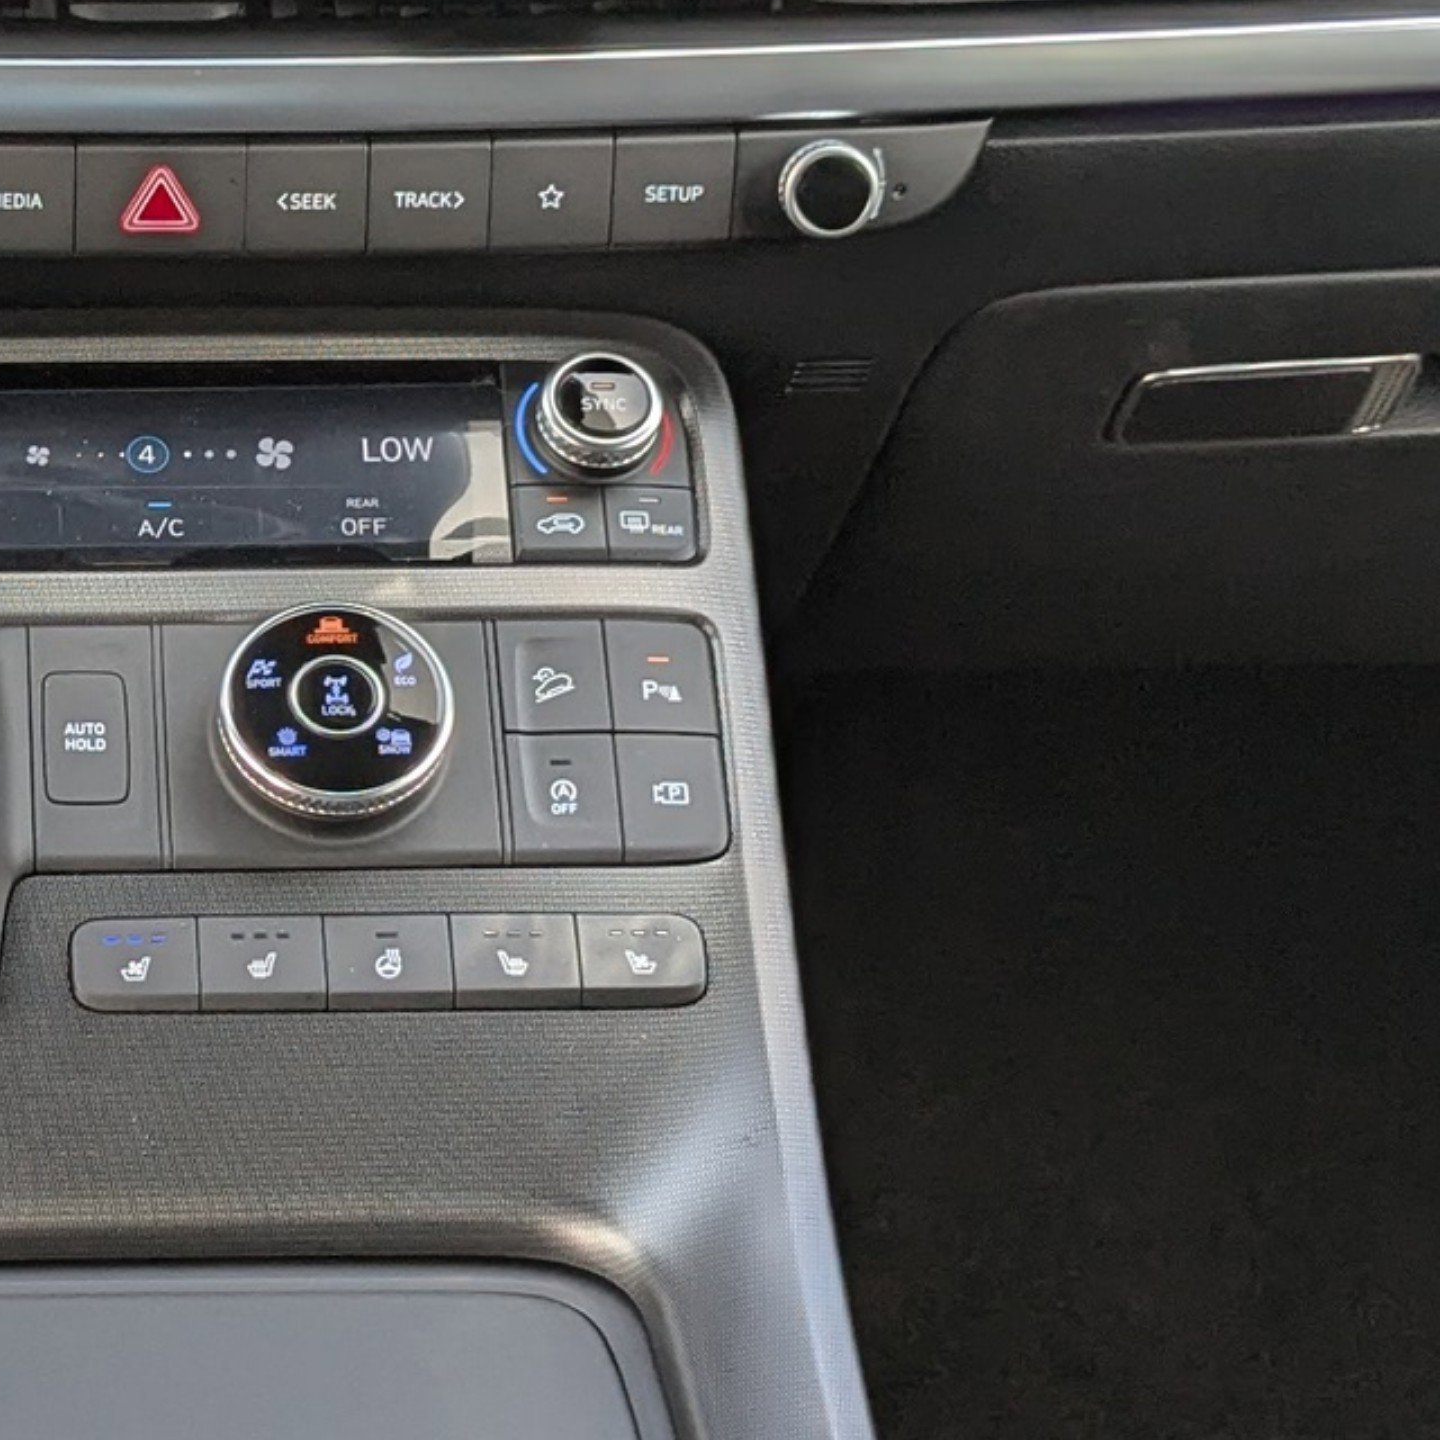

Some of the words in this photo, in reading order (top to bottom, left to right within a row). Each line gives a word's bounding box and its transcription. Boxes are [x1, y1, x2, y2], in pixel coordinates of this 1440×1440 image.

[645, 185, 704, 204] SETUP
[581, 396, 628, 413] SYNC
[137, 444, 157, 464] 4
[362, 437, 434, 463] LOW
[345, 497, 379, 509] REAR
[138, 517, 185, 539] A/C
[341, 517, 387, 536] OFF
[652, 524, 684, 536] REAR
[306, 633, 359, 645] COMFORT
[246, 677, 282, 689] SPORT
[394, 676, 417, 686] ECO
[642, 680, 657, 700] P
[64, 722, 106, 737] AUTO
[65, 737, 107, 752] HOLD
[268, 745, 307, 757] SMART
[377, 744, 412, 755] SNOW
[551, 803, 578, 815] OFF
